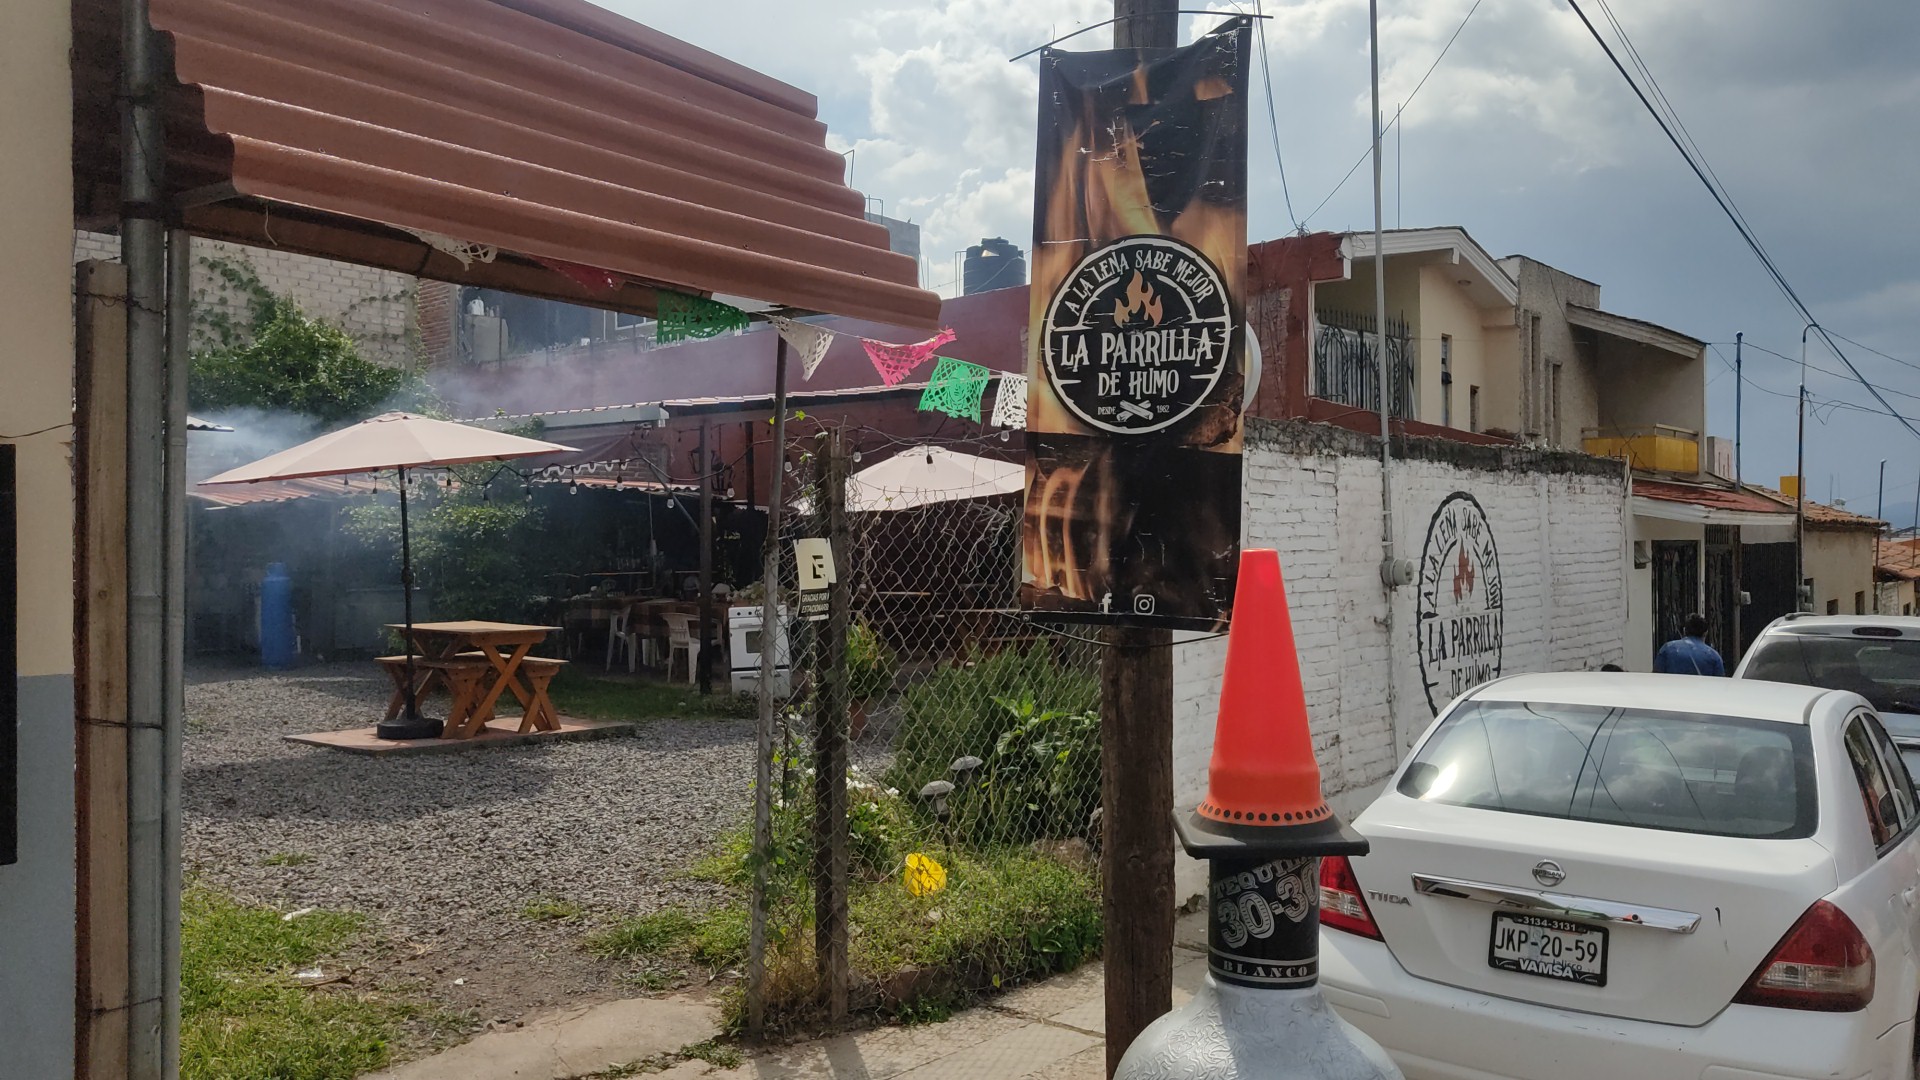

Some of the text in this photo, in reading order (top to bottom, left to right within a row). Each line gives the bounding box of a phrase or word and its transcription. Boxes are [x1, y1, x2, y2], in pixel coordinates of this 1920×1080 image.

[1135, 249, 1173, 272] SABE
[1072, 277, 1095, 300] LA
[1172, 258, 1214, 304] MEJOR
[1064, 300, 1081, 317] A
[1060, 327, 1213, 372] LA PARRILLA
[1098, 367, 1180, 400] DE HUMO
[1097, 406, 1117, 416] DESDE
[1461, 506, 1483, 547] SABE
[812, 555, 825, 579] E
[1425, 554, 1440, 586] LA
[1481, 539, 1502, 609] MEJOR
[801, 604, 829, 613] ESTACIONARS
[802, 594, 819, 603] GRACIAS
[1423, 591, 1435, 608] A
[1428, 612, 1500, 671] LA PARRILLA
[1450, 667, 1463, 700] DE
[1218, 862, 1319, 949] 30-30
[1368, 889, 1412, 907] TIIDA
[1523, 916, 1577, 932] 3134-3131
[1495, 927, 1598, 963] JKP-20-59
[1223, 960, 1308, 978] BLANCO
[1519, 958, 1574, 979] VAMSA
